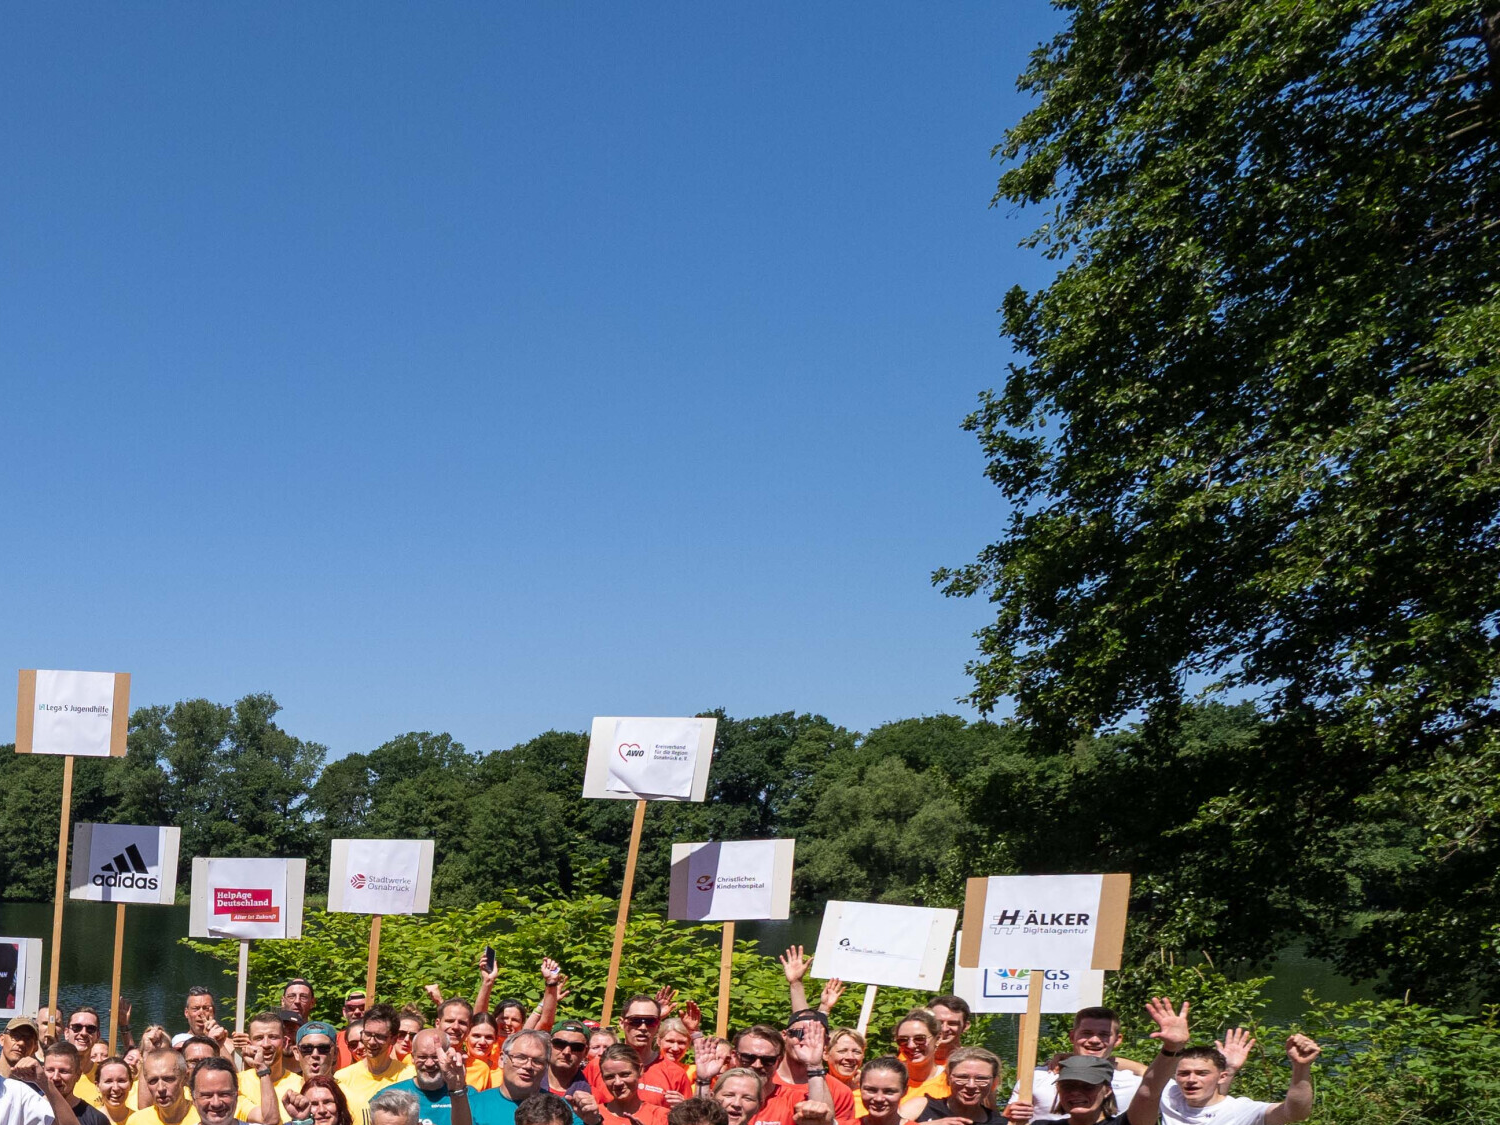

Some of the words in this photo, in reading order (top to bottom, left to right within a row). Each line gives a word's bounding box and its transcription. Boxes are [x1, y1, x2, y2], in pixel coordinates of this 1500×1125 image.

[46, 704, 62, 712] Lega
[70, 705, 109, 714] Jugendhilfe
[626, 749, 645, 757] AWO
[92, 871, 158, 890] adidas
[368, 875, 411, 884] Stadtwerke
[217, 891, 252, 899] HelpAge
[217, 899, 269, 907] Deutschland
[1023, 926, 1089, 935] Digitalagentur
